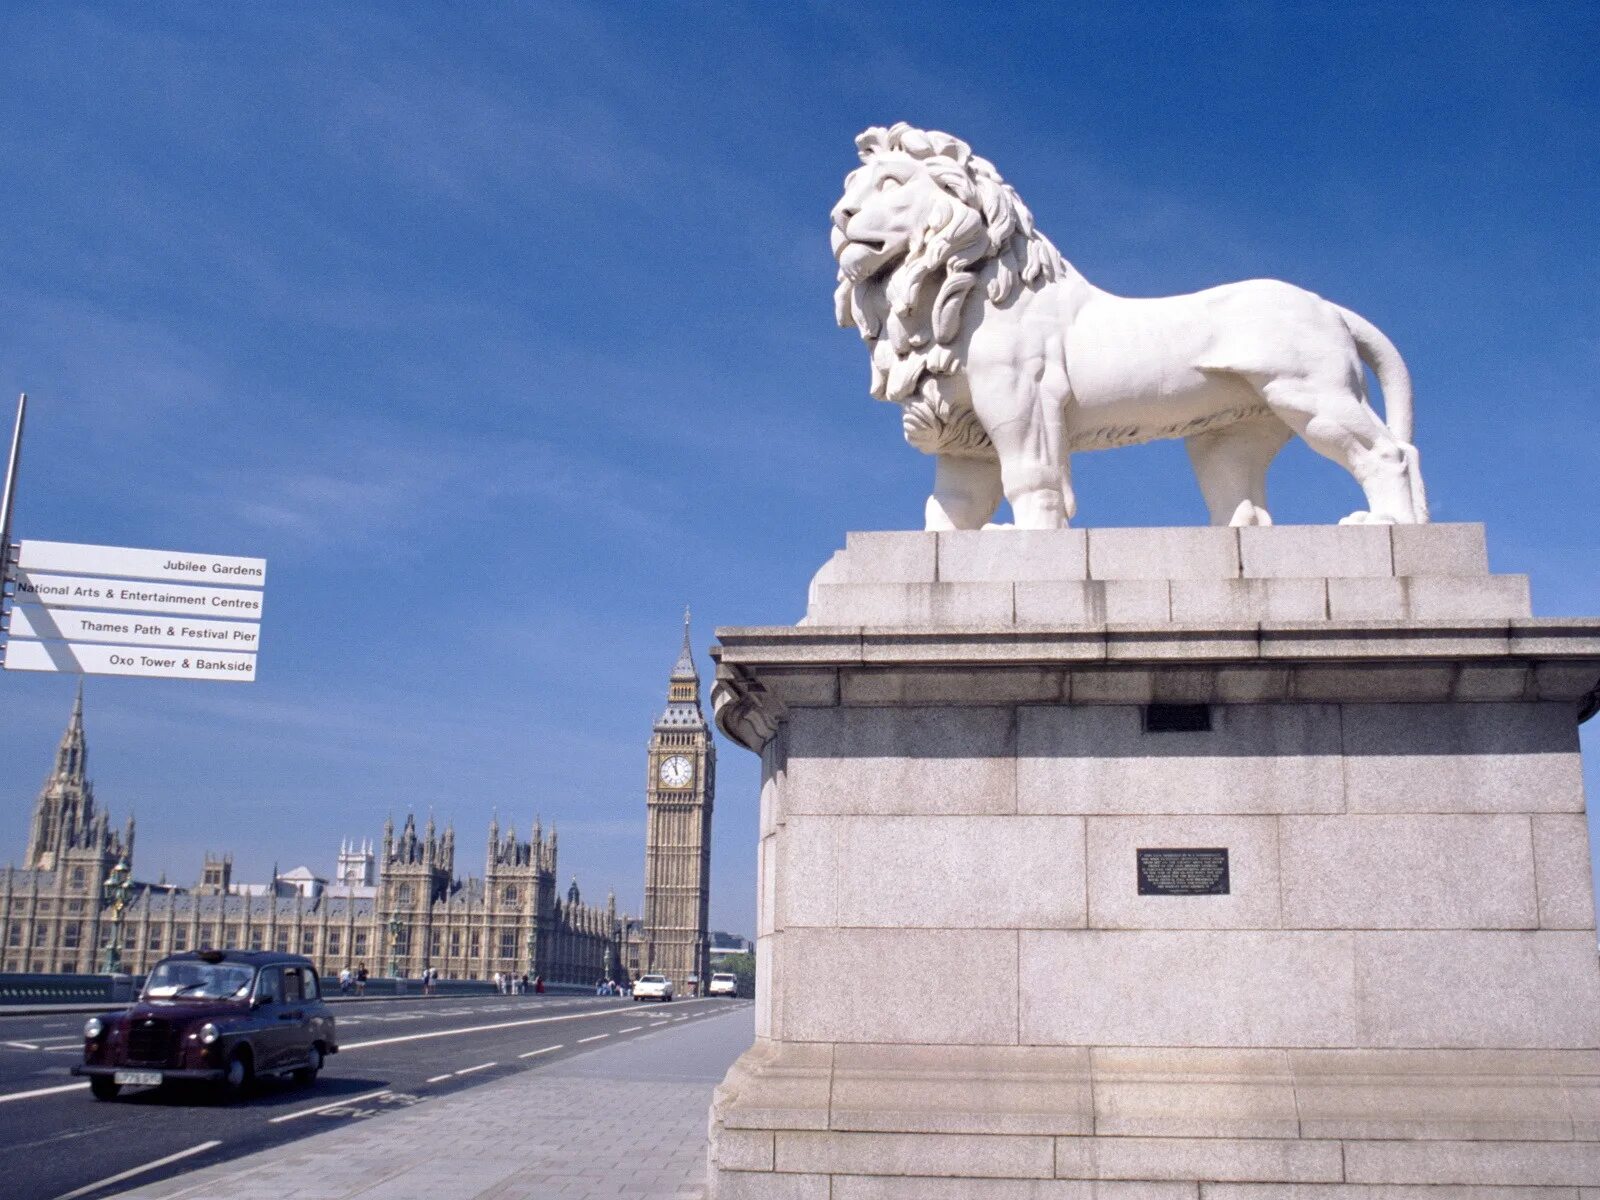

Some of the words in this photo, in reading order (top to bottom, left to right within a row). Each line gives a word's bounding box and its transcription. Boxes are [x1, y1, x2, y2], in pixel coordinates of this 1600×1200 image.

[163, 560, 207, 572] Jubilee
[212, 563, 262, 576] Gardens
[17, 582, 69, 596] National
[74, 587, 100, 598] Arts
[106, 589, 114, 599] &
[120, 590, 206, 605] Entertainment
[211, 596, 259, 609] Centres
[81, 620, 128, 633] Thames
[134, 624, 161, 635] Path
[166, 626, 175, 636] &
[181, 627, 228, 639] Festival
[233, 630, 256, 641] Pier
[109, 654, 134, 666] Oxo
[140, 656, 176, 668] Tower
[182, 658, 190, 669] &
[196, 659, 253, 671] Bankside
